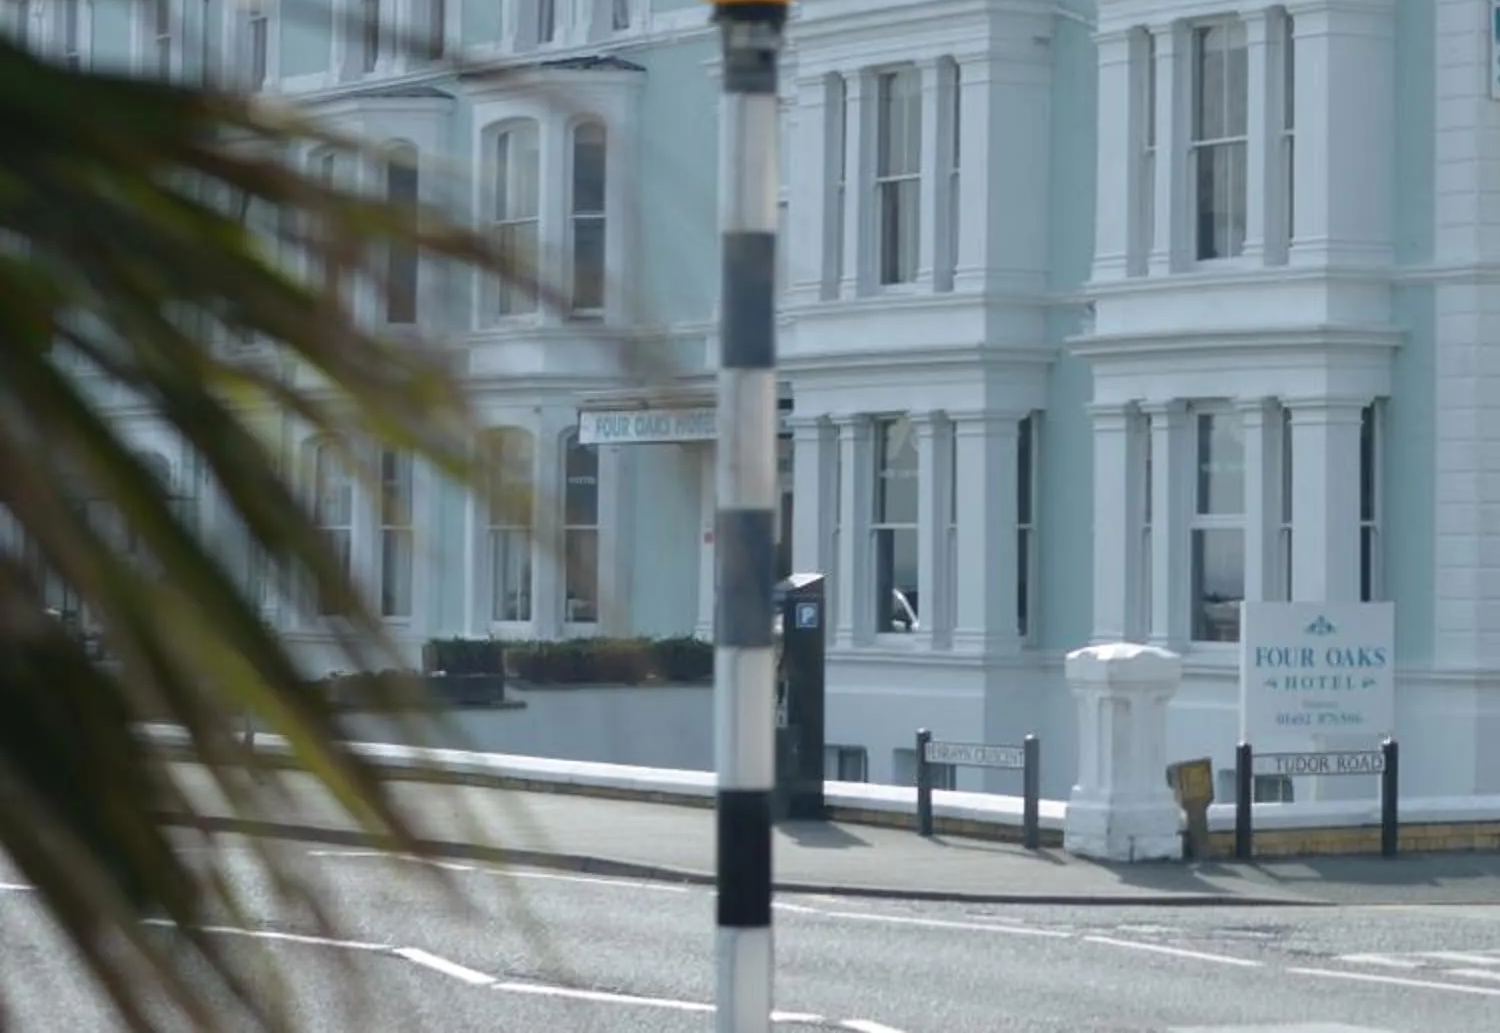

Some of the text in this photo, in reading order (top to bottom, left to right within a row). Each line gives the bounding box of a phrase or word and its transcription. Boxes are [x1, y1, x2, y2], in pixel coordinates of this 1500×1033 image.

[596, 414, 630, 436] FOUR
[801, 606, 814, 624] P
[1256, 647, 1387, 667] FOUR OAKS
[1285, 675, 1356, 691] HOTEL
[1276, 754, 1383, 772] TUDOR ROAD
